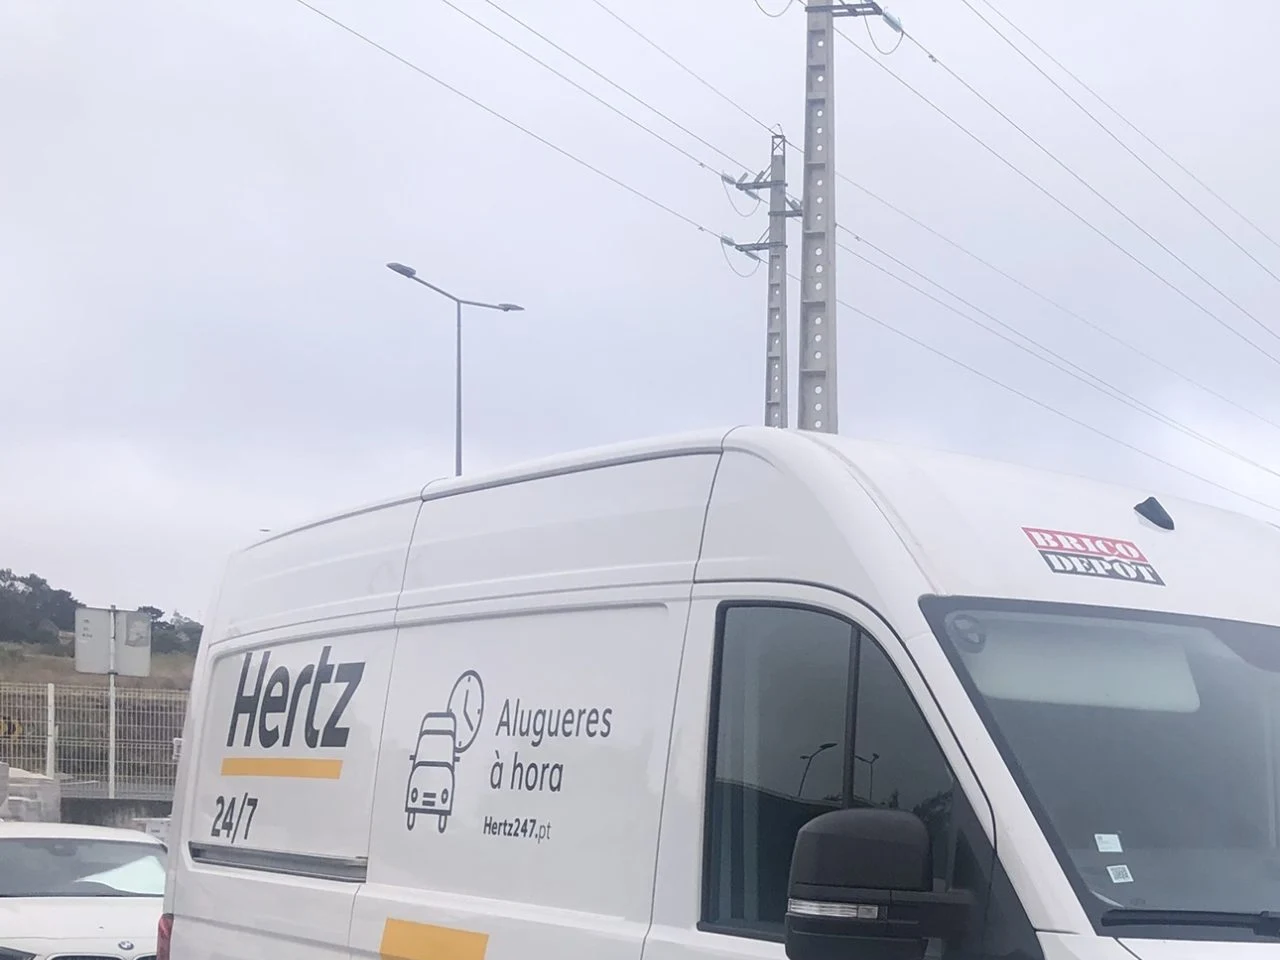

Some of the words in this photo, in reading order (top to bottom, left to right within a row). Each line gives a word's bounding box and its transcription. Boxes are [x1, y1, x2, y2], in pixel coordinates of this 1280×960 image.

[1028, 530, 1139, 559] BRICO
[226, 645, 366, 749] Hertz
[495, 698, 613, 747] Alugueres
[490, 750, 504, 790] à
[510, 751, 564, 792] hora
[210, 792, 259, 844] 24/7
[483, 816, 552, 844] Hertz247.pt
